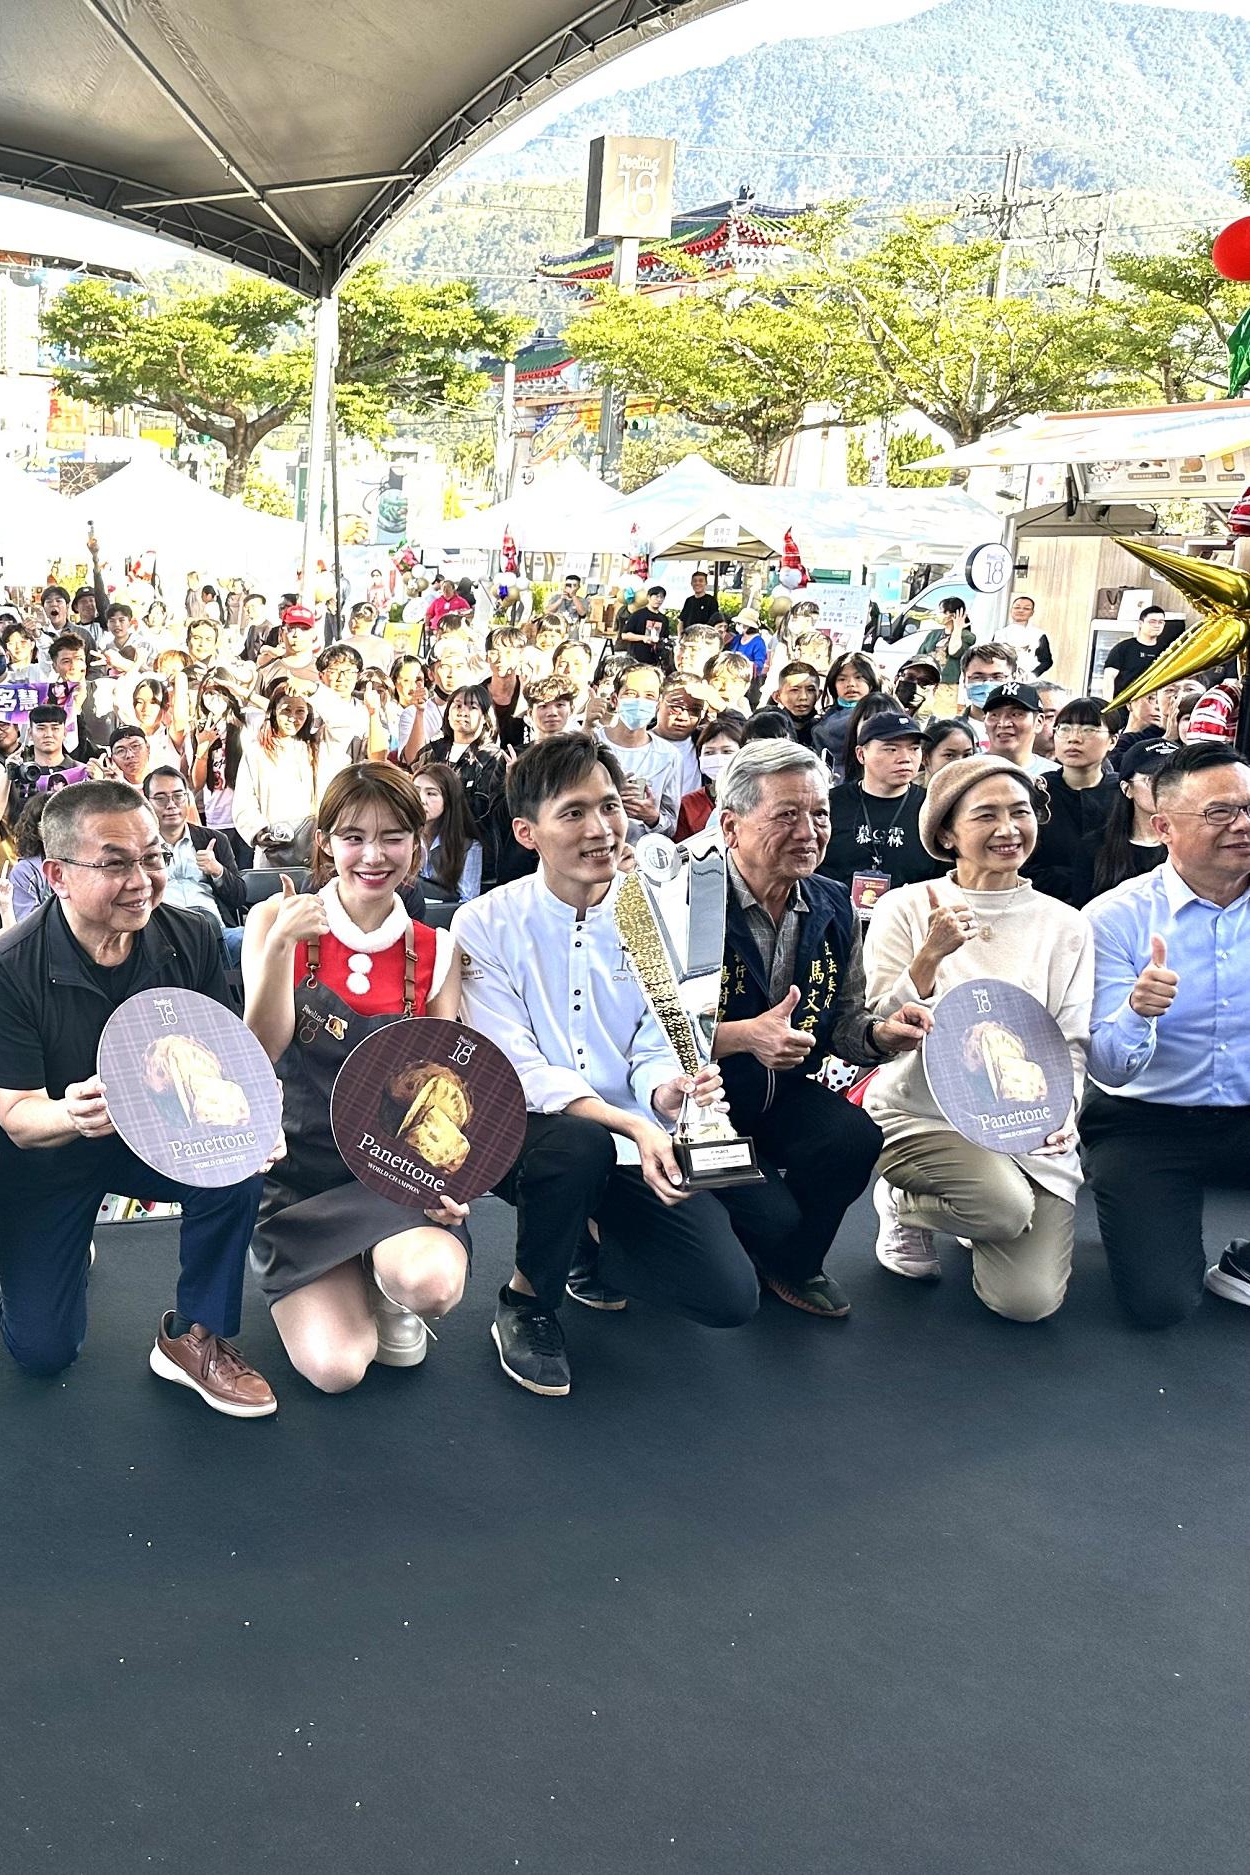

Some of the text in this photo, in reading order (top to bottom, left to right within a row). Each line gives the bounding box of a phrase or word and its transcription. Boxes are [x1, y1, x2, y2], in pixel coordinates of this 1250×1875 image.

[618, 154, 660, 176] Feeling
[617, 170, 657, 217] 18
[985, 561, 1004, 585] 18
[1002, 682, 1020, 696] NY
[798, 959, 825, 1034] 馬文君
[973, 994, 992, 1014] 18
[156, 1005, 178, 1026] 18
[298, 1011, 319, 1043] 18
[302, 1003, 327, 1026] Feeling
[448, 1040, 473, 1066] 18
[457, 1034, 478, 1050] Feeling
[978, 1105, 1052, 1131] Panettone
[168, 1130, 257, 1160] Panettone
[194, 1154, 247, 1170] WORLD CHAMPION
[356, 1132, 446, 1192] Panettone
[367, 1161, 421, 1195] WORLD CHAMPION
